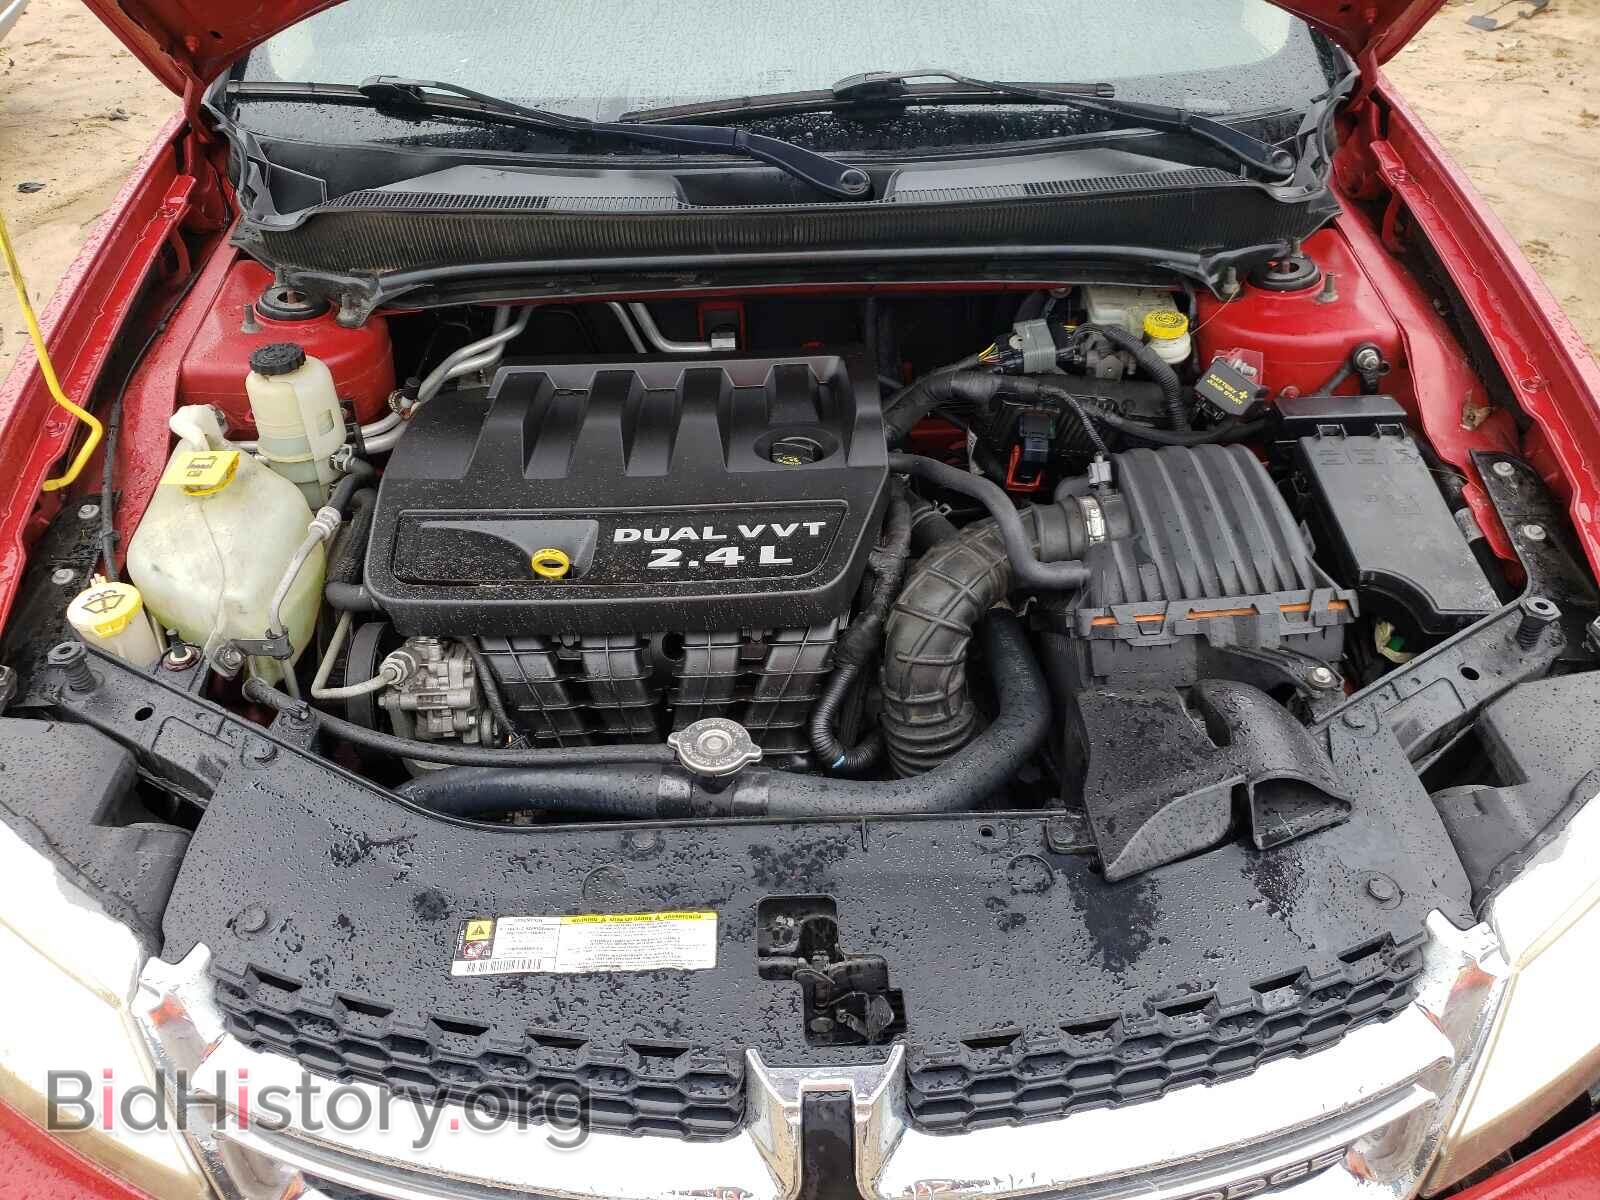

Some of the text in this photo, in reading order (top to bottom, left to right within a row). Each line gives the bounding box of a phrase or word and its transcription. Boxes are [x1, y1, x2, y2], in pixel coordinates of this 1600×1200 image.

[613, 521, 827, 542] DUAL VVT
[647, 545, 793, 569] 2.4 L
